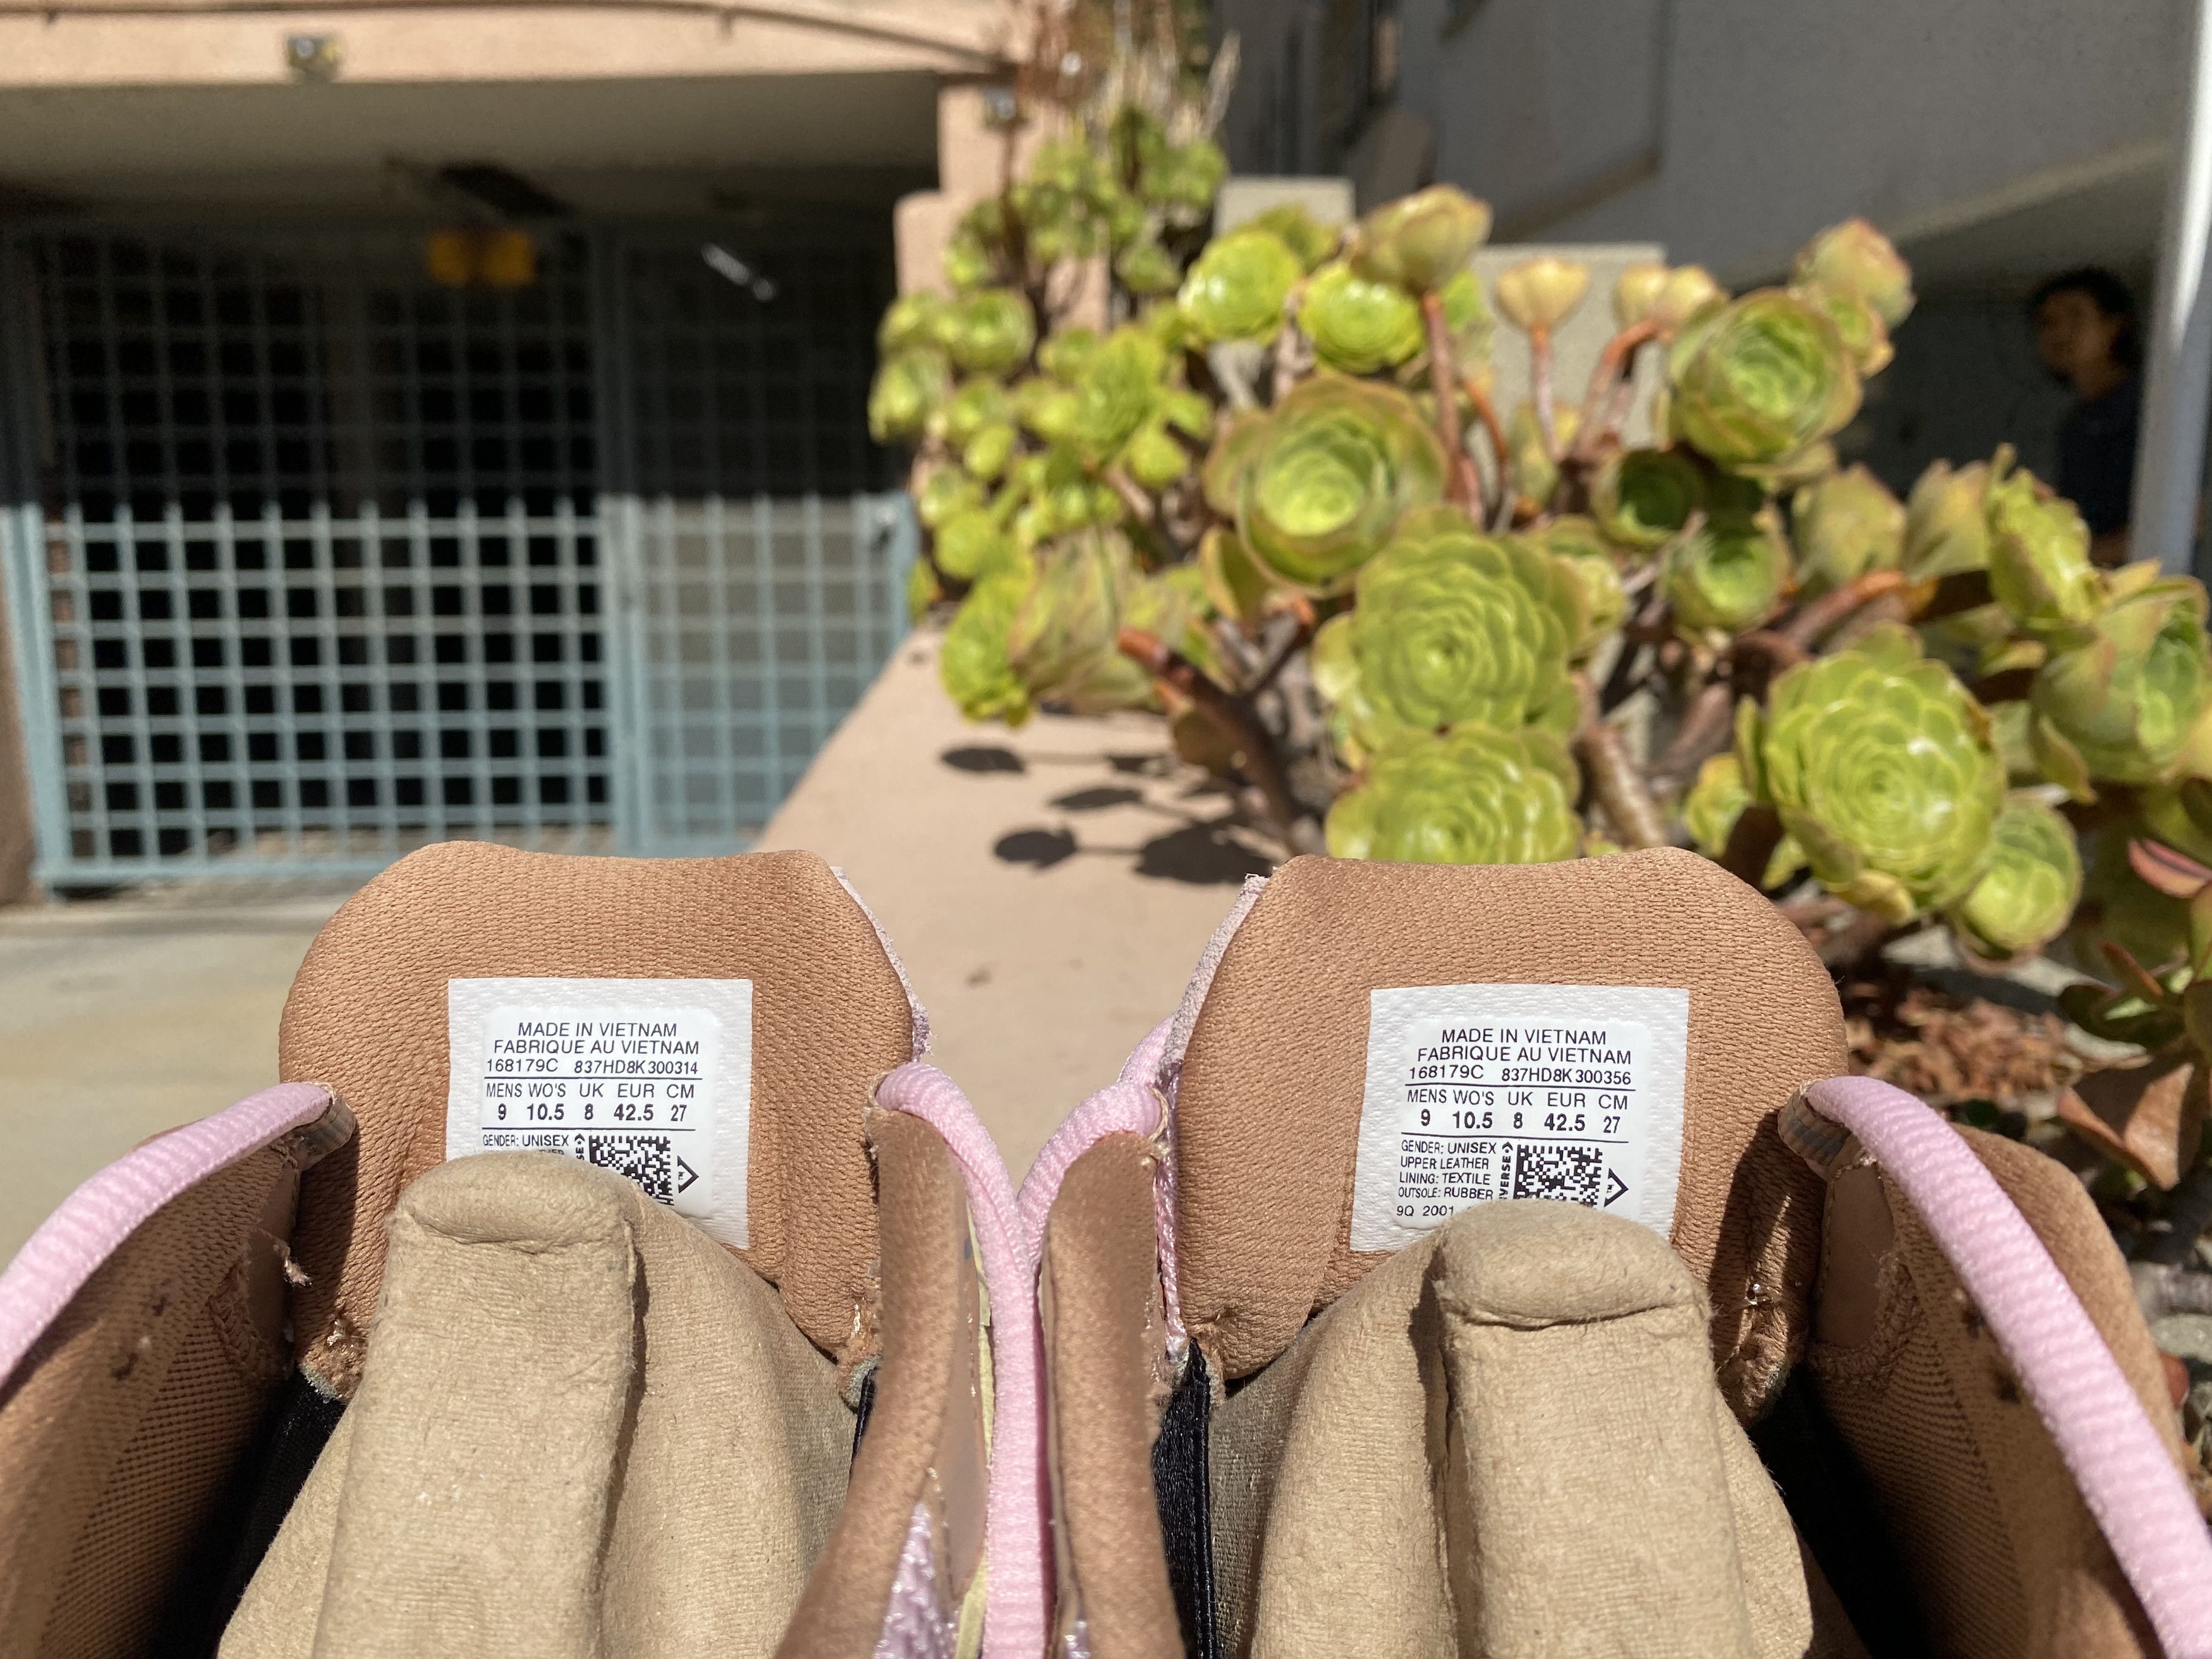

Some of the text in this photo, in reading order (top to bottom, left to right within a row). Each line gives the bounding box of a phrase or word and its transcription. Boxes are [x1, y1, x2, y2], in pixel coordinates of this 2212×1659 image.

[518, 1022, 677, 1037] MADE IN VIETNAM
[1442, 1028, 1606, 1045] MADE IN VIETNAM
[494, 1040, 699, 1055] FABRIQUE AU VIETNAM
[1418, 1045, 1631, 1065] FABRIQUE AU VIETNAM
[487, 1057, 559, 1073] 168179C
[1409, 1064, 1484, 1079] 168179C
[486, 1083, 695, 1098] MENS WO'S UK EUR CM
[1407, 1088, 1628, 1110] MENS WO'S UK EUR CM
[497, 1103, 687, 1122] 9 10.5 8 42.5 27
[1421, 1109, 1621, 1134] 9 10.5 8 42.5 27
[483, 1134, 569, 1147] GENDER: UNISEX
[1401, 1139, 1497, 1155] GENDER: UNISEX
[1440, 1157, 1489, 1170] LEATHER
[1399, 1171, 1491, 1186] LINING: TEXTILE
[1498, 1155, 1512, 1200] VERSE
[1398, 1186, 1493, 1201] OUTSOLE: RUBBER
[1396, 1205, 1414, 1217] 9Q
